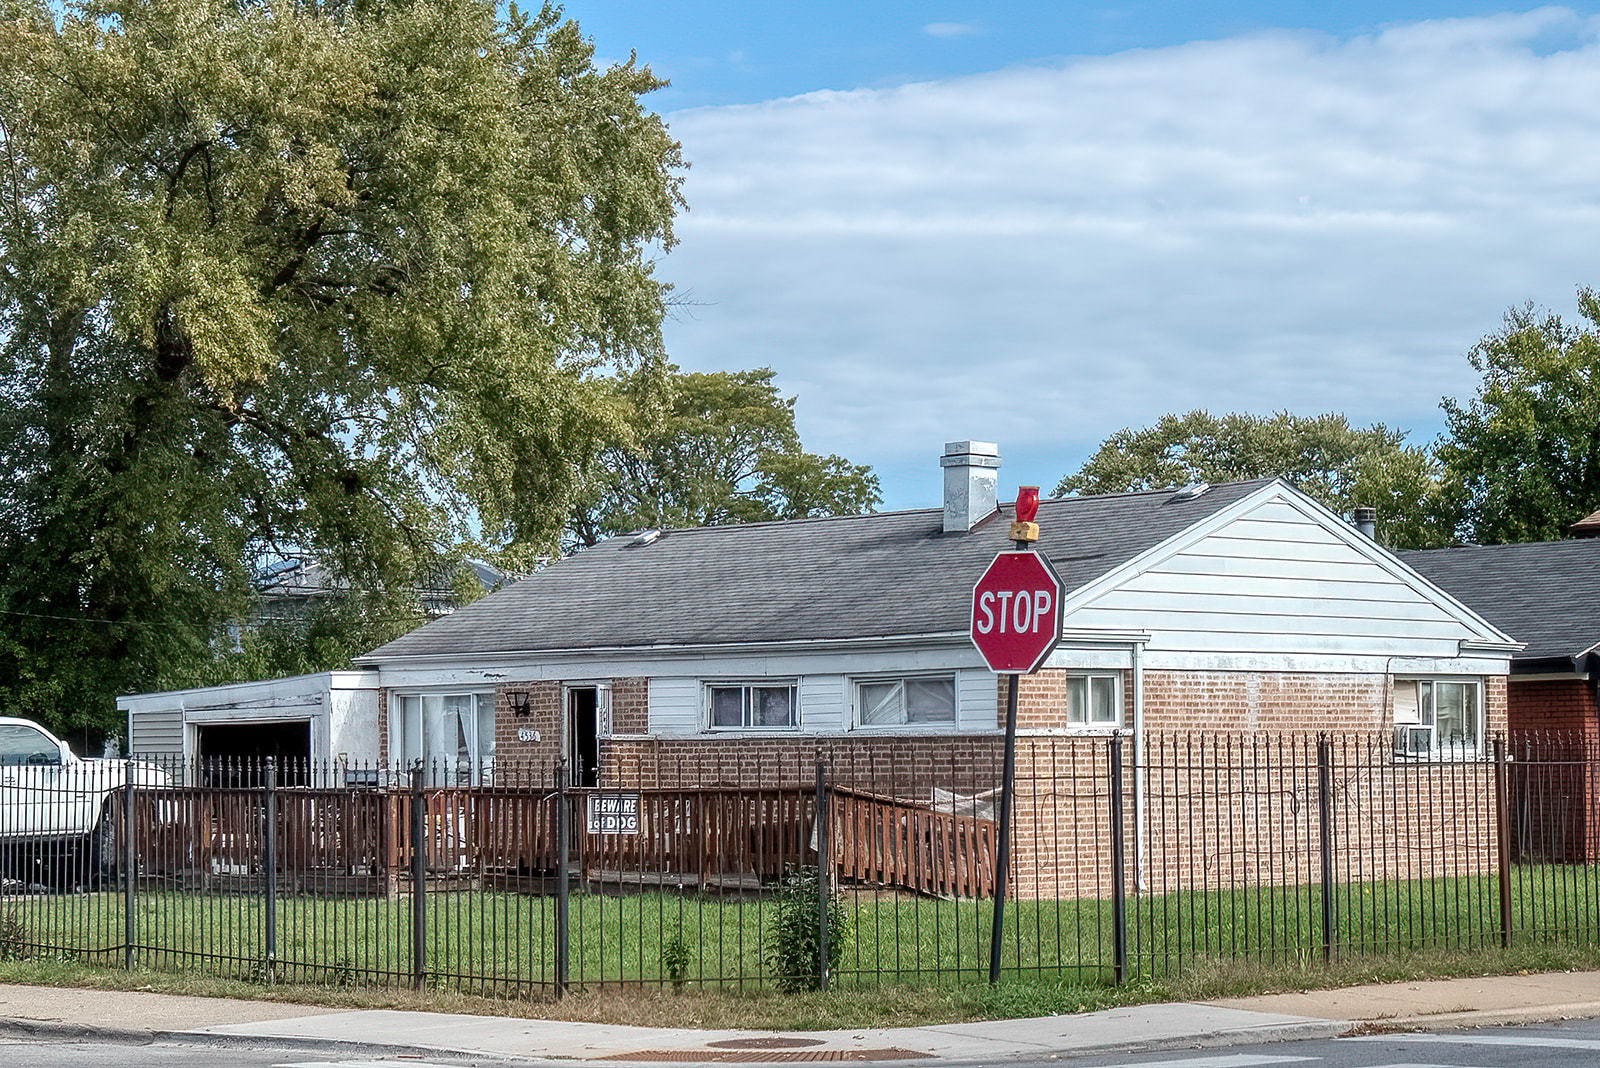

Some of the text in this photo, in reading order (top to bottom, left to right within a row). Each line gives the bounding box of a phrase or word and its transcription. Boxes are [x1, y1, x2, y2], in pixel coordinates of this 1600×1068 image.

[977, 590, 1051, 634] STOP
[594, 799, 637, 813] BEWARE
[607, 816, 637, 829] DOG
